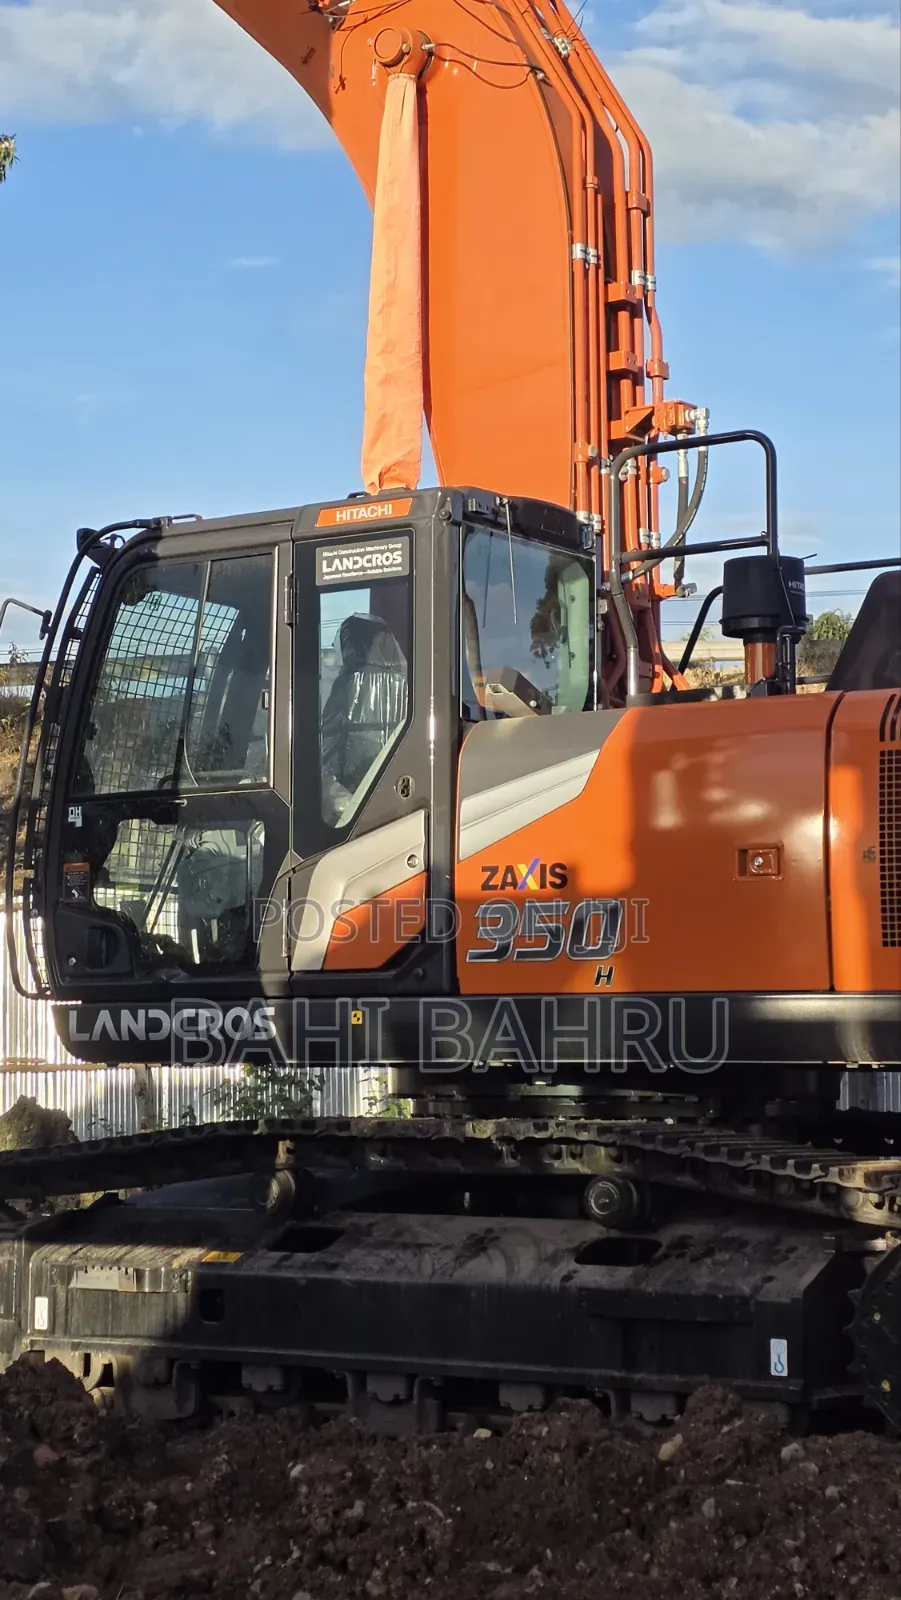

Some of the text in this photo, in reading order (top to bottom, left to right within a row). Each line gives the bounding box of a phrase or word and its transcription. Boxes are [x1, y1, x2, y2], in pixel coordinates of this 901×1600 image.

[336, 503, 392, 522] HITACHI
[322, 551, 402, 573] LANDCROS
[481, 857, 568, 891] ZAXIS
[465, 900, 623, 963] 350
[594, 965, 615, 987] H
[68, 1006, 277, 1041] LANDCROS
